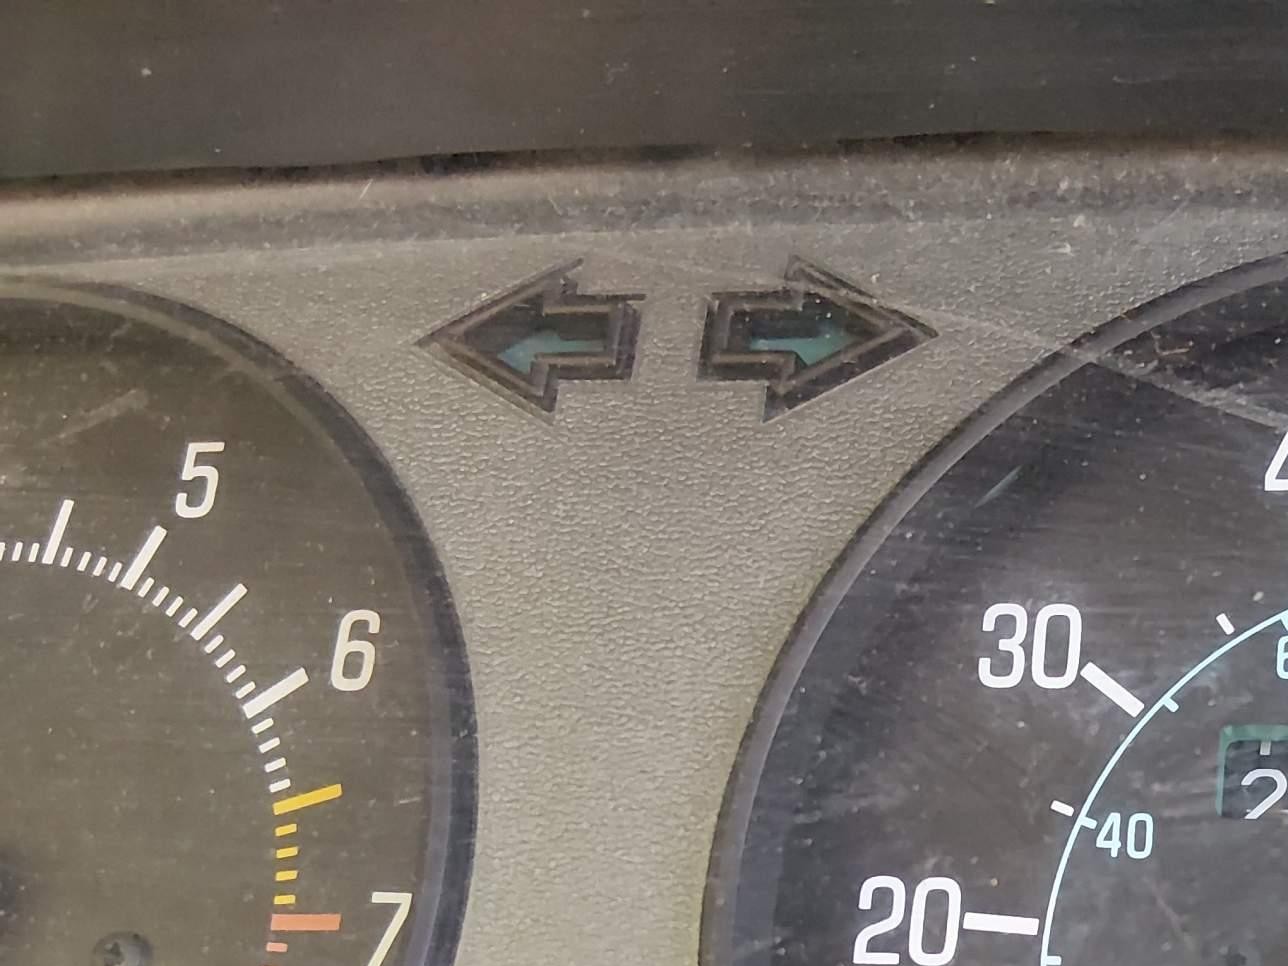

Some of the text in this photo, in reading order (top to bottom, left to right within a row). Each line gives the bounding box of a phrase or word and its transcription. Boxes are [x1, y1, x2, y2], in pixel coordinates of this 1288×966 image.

[175, 441, 226, 519] 5
[330, 609, 381, 692] 6
[977, 602, 1083, 690] 30
[1096, 812, 1154, 859] 40
[853, 874, 962, 966] 20
